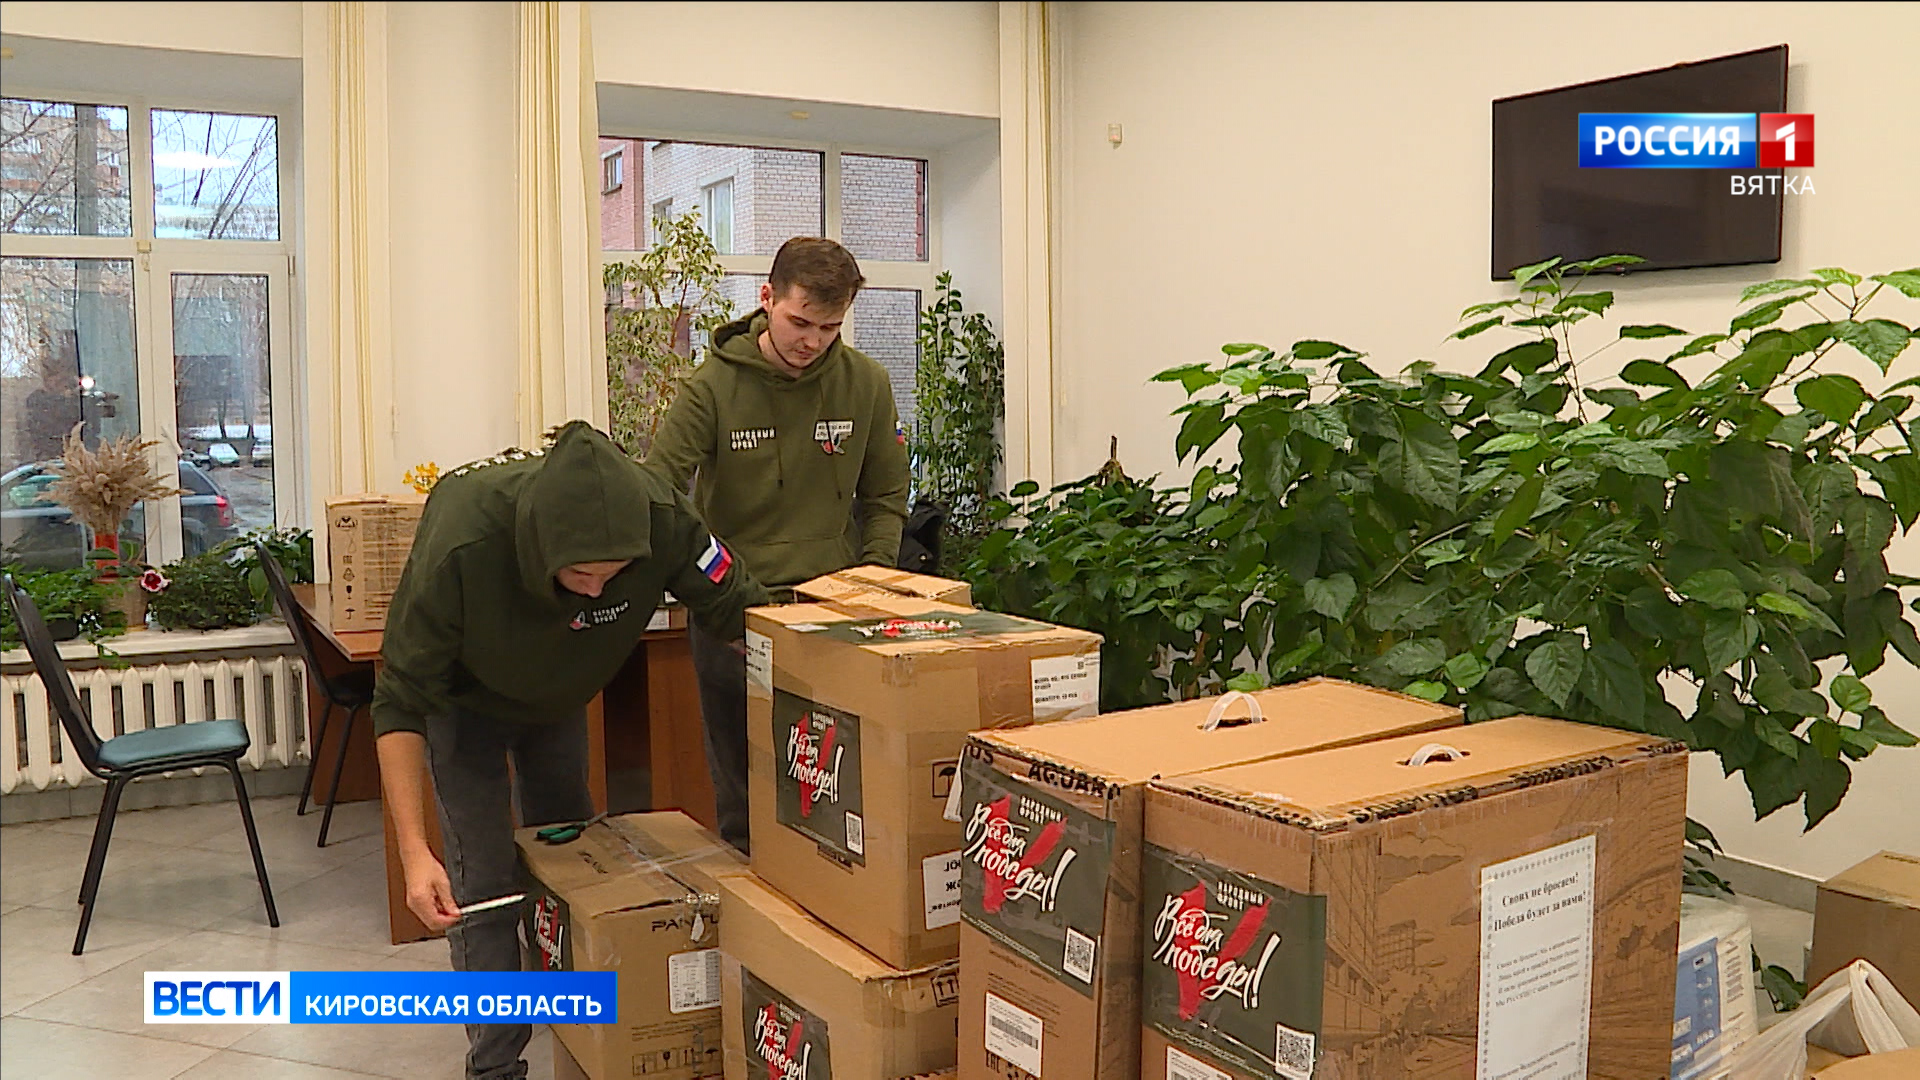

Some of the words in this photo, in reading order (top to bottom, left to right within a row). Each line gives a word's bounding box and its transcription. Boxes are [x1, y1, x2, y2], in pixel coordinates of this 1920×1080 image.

[1218, 881, 1264, 906] НАРОДНЫЙ
[1502, 891, 1529, 908] Своих
[1531, 887, 1542, 898] не
[1543, 871, 1579, 896] бросаем!
[1494, 914, 1525, 932] Победа
[1526, 905, 1550, 922] будет
[1552, 901, 1560, 912] за
[1561, 889, 1587, 908] нами!
[1163, 933, 1281, 1010] победы!
